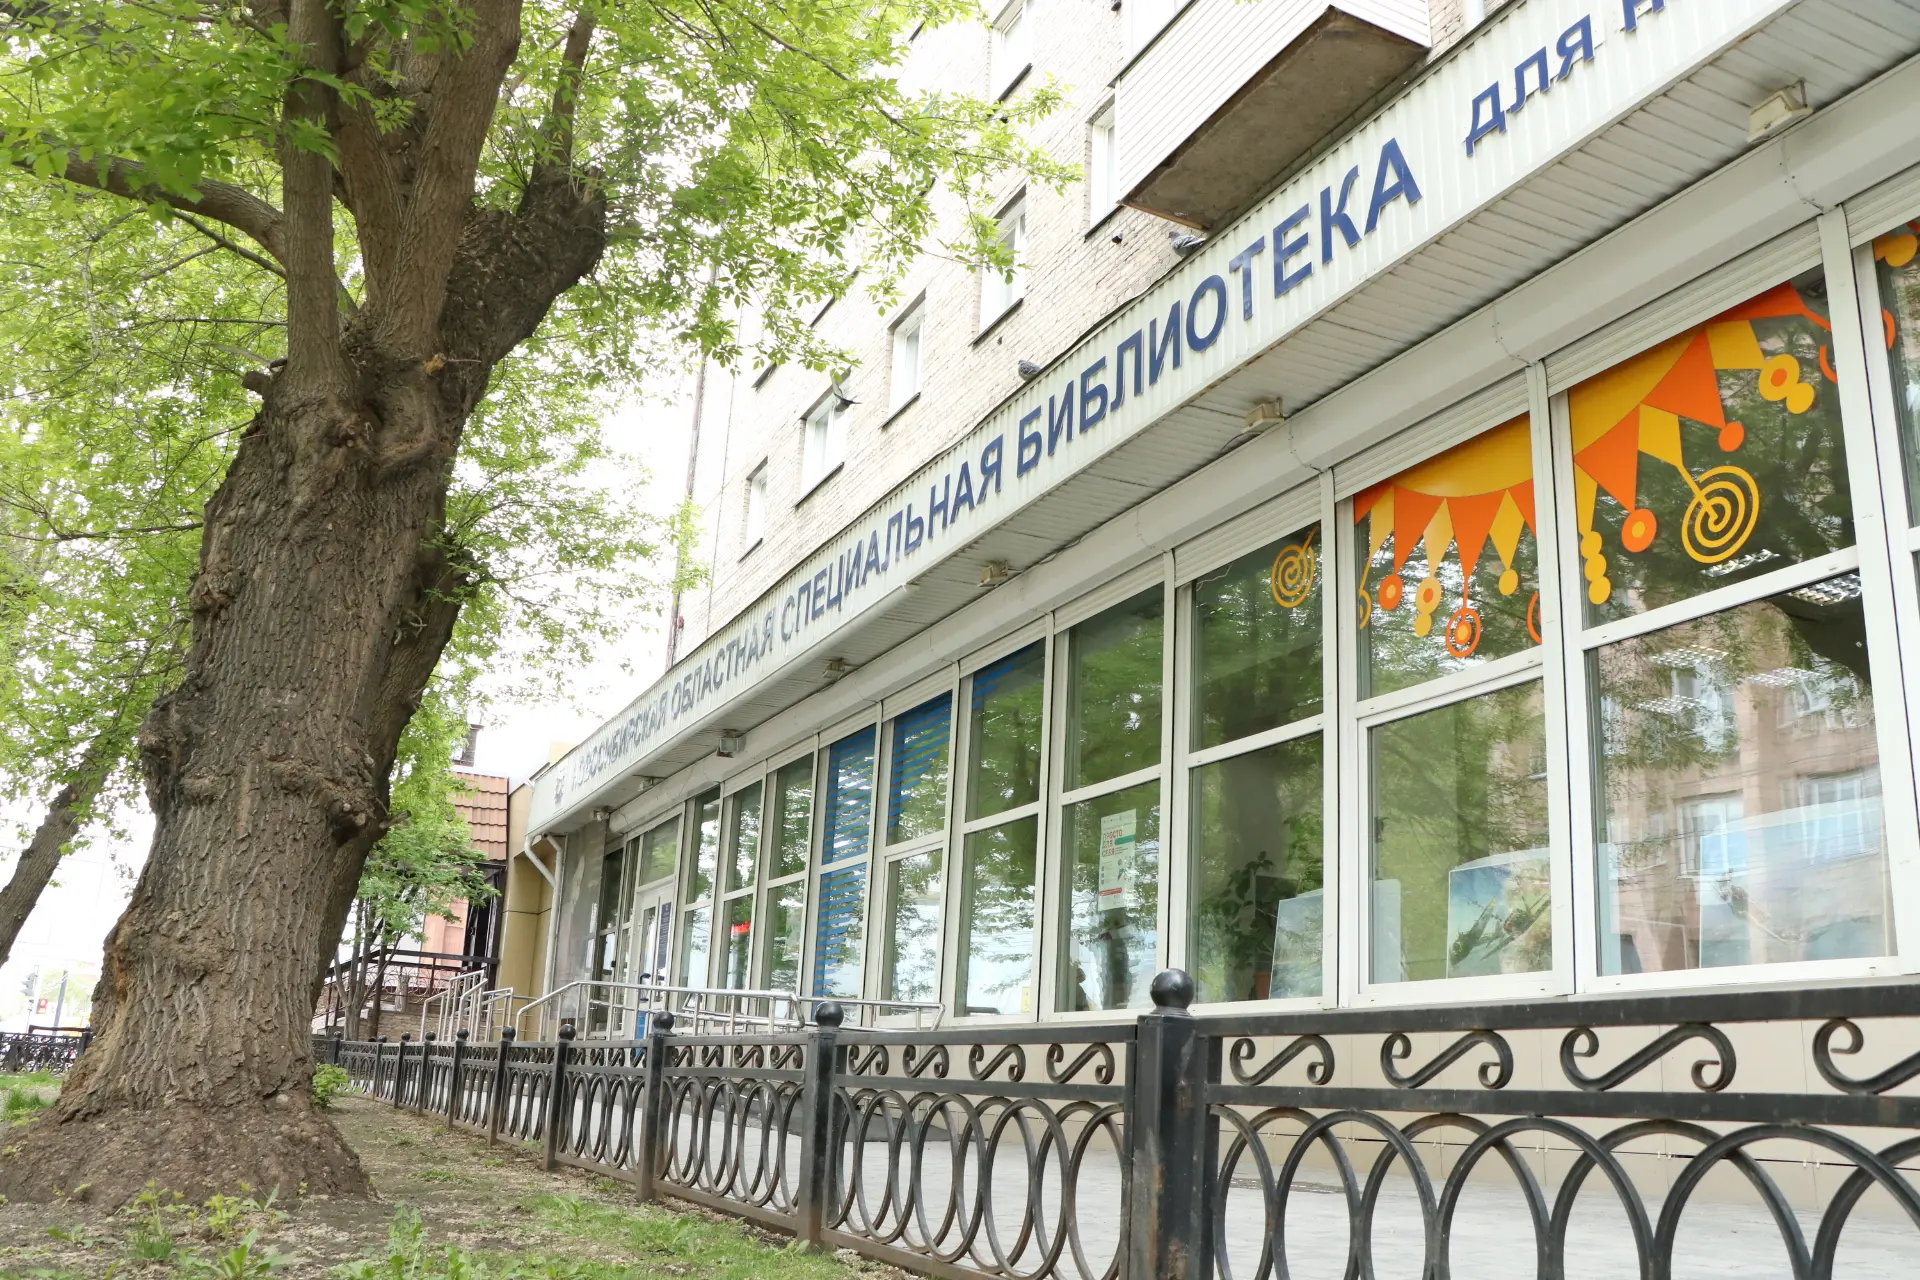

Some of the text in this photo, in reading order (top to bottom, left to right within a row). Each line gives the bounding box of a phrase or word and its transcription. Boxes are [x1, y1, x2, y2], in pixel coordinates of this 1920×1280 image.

[671, 607, 776, 720] ОБЛАСТНАЯ
[780, 433, 1004, 643] СПЕЦИАЛЬНАЯ
[1016, 137, 1423, 478] БИБЛИОТЕКА
[1465, 13, 1594, 157] ДЛЯ
